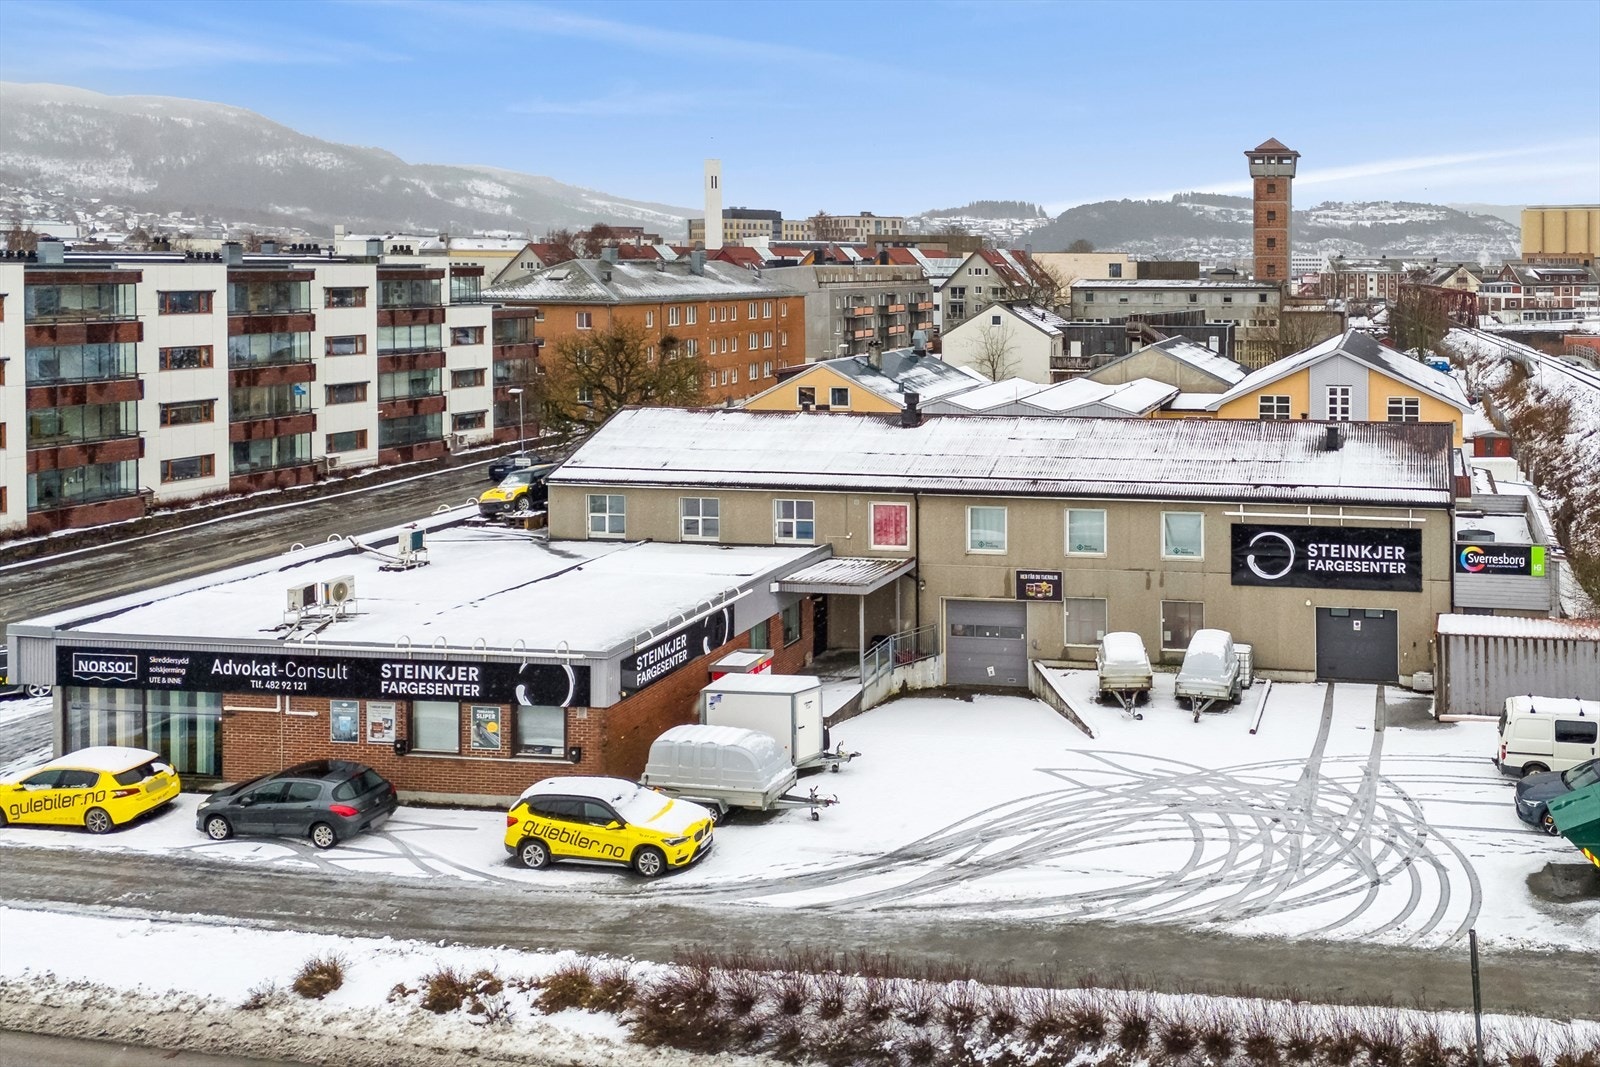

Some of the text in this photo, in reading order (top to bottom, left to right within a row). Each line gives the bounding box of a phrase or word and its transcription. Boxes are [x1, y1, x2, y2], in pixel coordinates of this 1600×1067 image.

[1307, 543, 1405, 560] STEINKJER
[1467, 552, 1525, 567] Sverresborg
[1307, 560, 1406, 574] FARGESENTER
[636, 634, 687, 671] STEINKJER
[78, 660, 132, 674] NORSOL
[211, 658, 348, 681] Advokat-Consult
[381, 663, 479, 682] STEINKJER
[636, 650, 687, 686] FARGESENTER
[149, 676, 161, 684] UTE
[250, 680, 307, 690] Tlf. 482 92 121
[381, 681, 480, 697] FARGESENTER
[10, 790, 106, 820] gulebiler.no
